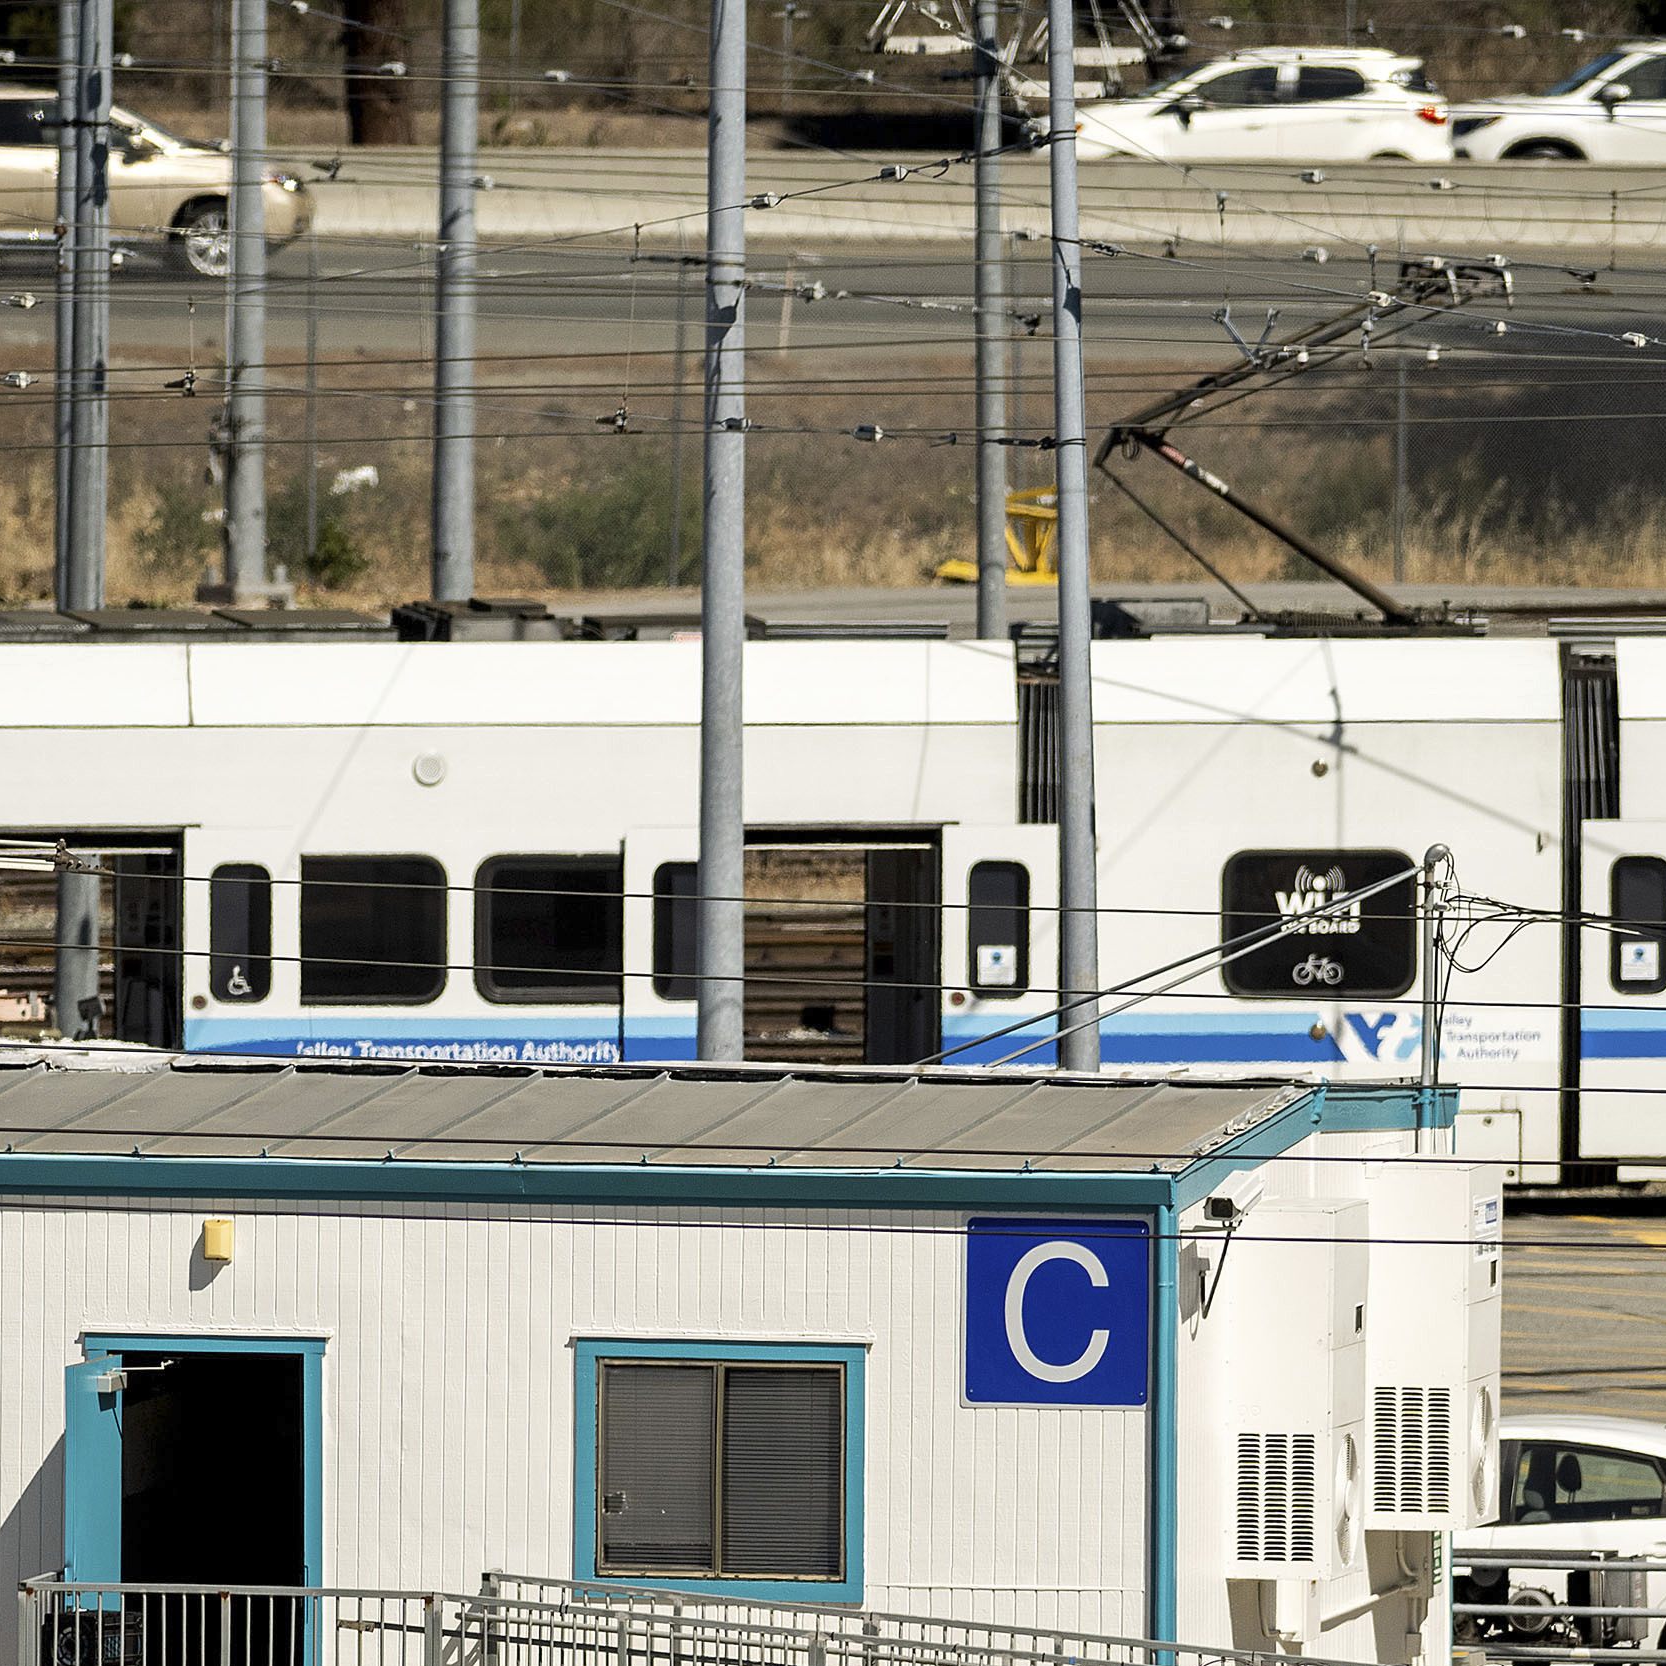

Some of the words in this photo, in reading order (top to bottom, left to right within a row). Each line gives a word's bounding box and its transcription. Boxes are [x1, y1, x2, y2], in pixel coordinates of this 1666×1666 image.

[1309, 920, 1361, 935] BOARD
[1444, 1014, 1473, 1028] alley
[1446, 1030, 1542, 1044] Transportation
[355, 1040, 517, 1060] Transportation
[1457, 1047, 1519, 1061] Authority
[1005, 1241, 1110, 1383] C
